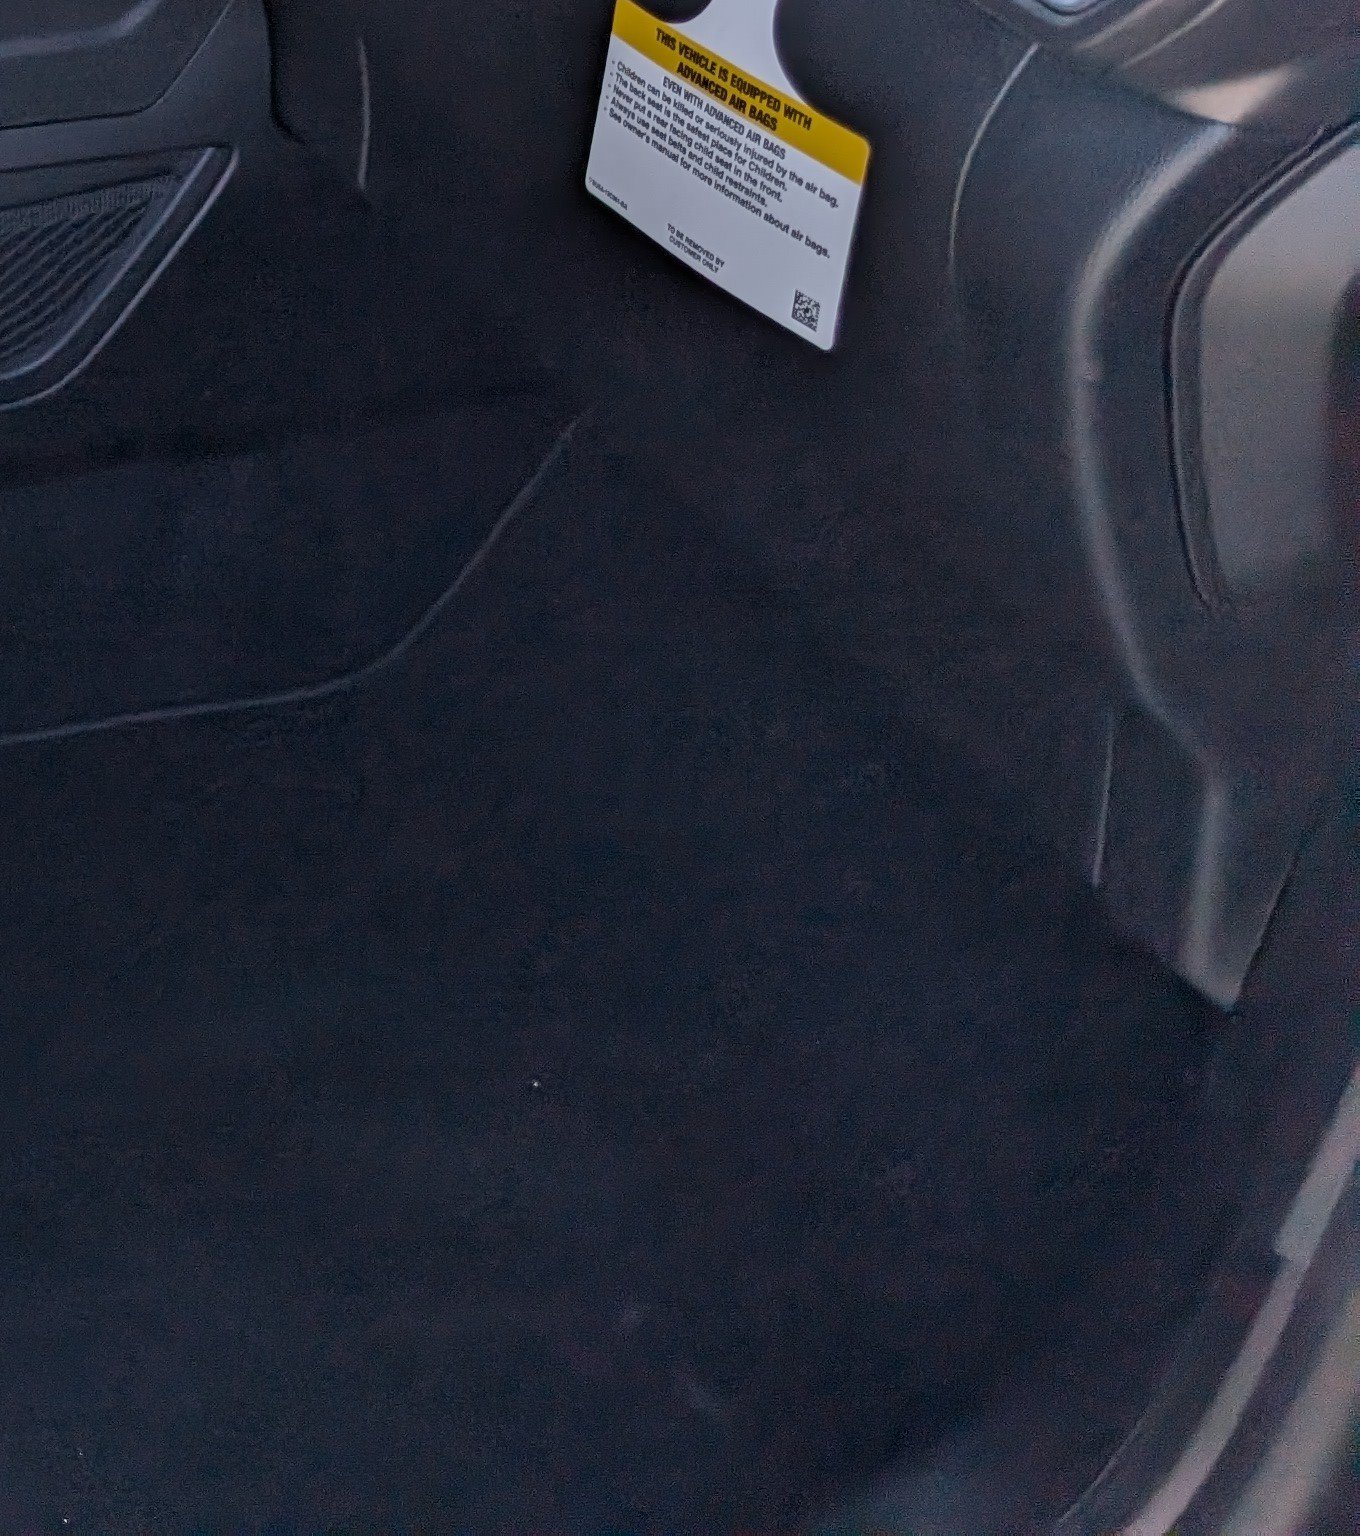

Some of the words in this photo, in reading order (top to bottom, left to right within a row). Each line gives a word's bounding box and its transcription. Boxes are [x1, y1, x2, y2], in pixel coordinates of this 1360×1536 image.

[615, 72, 628, 88] The
[629, 81, 646, 101] back
[646, 96, 662, 112] seat
[672, 112, 685, 126] the
[685, 122, 710, 143] safest
[709, 138, 732, 158] place
[733, 149, 746, 166] for
[748, 160, 787, 191] Children.
[616, 60, 646, 88] Children
[646, 83, 660, 98] can
[672, 98, 694, 119] killed
[704, 121, 742, 151] seriously
[743, 143, 774, 169] injured
[788, 170, 804, 186] the
[804, 181, 817, 194] air
[818, 187, 838, 208] bag.
[656, 27, 676, 51] THIS
[678, 41, 717, 75] VEHICLE
[717, 65, 728, 82] IS
[729, 73, 781, 112] EQUIPPED
[783, 103, 812, 130] WITH
[662, 75, 682, 96] EVEN
[683, 88, 702, 110] WITH
[703, 102, 744, 135] ADVANCED
[745, 129, 761, 146] AIR
[762, 137, 786, 160] BAGS
[676, 61, 728, 102] ADVANCED
[728, 93, 746, 114] AIR
[747, 104, 778, 131] BAGS
[608, 107, 621, 123] See
[622, 119, 650, 144] owner's
[650, 139, 679, 163] manual
[679, 156, 691, 171] for
[691, 167, 712, 186] more
[713, 179, 761, 217] information
[763, 212, 789, 234] about
[790, 229, 803, 241] air
[804, 235, 830, 258] bags.
[610, 96, 635, 120] Always
[636, 115, 649, 130] use
[650, 125, 667, 142] seat
[667, 135, 686, 155] belts
[687, 150, 703, 166] and
[703, 161, 724, 180] child
[724, 175, 767, 207] restraints.
[612, 83, 633, 104] Never
[633, 100, 646, 114] put
[652, 113, 668, 128] rear
[669, 122, 692, 148] facing
[693, 141, 714, 159] child
[714, 155, 732, 172] seat
[743, 171, 758, 187] the
[759, 180, 782, 202] front.
